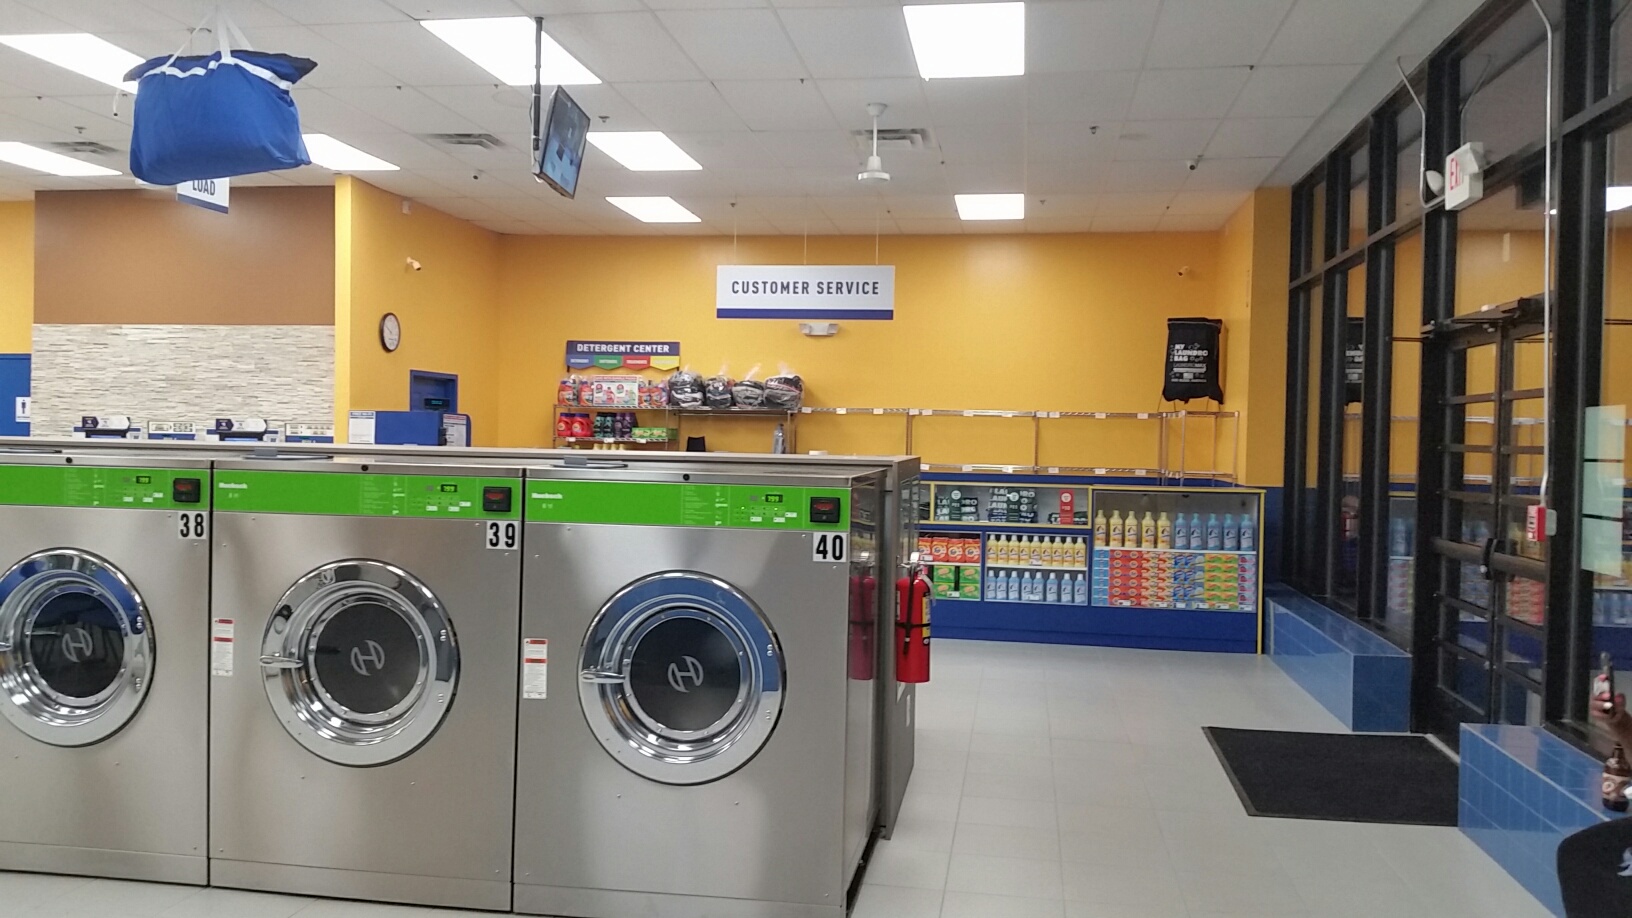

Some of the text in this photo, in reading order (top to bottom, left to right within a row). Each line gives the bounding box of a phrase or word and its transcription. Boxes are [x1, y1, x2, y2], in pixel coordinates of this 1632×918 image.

[192, 179, 216, 196] LOAD
[731, 280, 880, 295] CUSTOMER SERVICE
[576, 343, 670, 353] DETERGENT CENTER
[179, 513, 204, 538] 38
[488, 522, 516, 548] 39
[815, 534, 844, 561] 40
